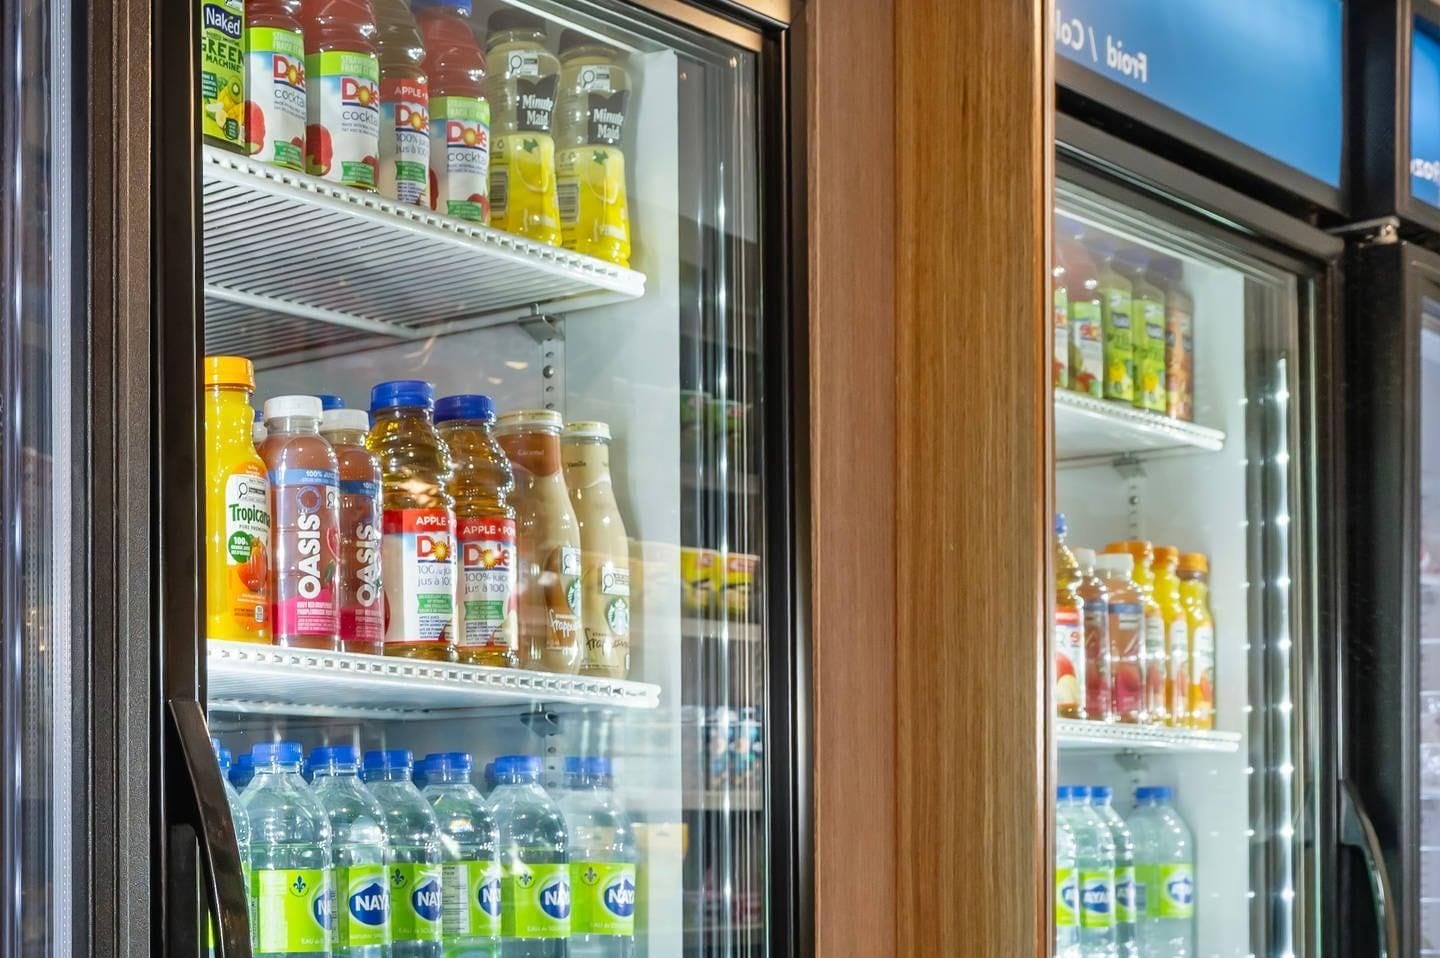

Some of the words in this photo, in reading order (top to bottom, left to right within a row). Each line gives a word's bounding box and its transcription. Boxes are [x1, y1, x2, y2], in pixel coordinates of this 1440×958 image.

[206, 6, 241, 36] Naked
[205, 54, 241, 73] MACHINE
[394, 85, 422, 98] APPLE
[522, 94, 554, 112] Minute
[526, 109, 550, 126] Maid
[592, 107, 625, 126] Minute
[596, 123, 620, 140] Maid
[416, 515, 447, 527] APPLE
[463, 524, 497, 536] APPLE
[298, 514, 321, 599] OASIS
[356, 523, 374, 607] OASIS
